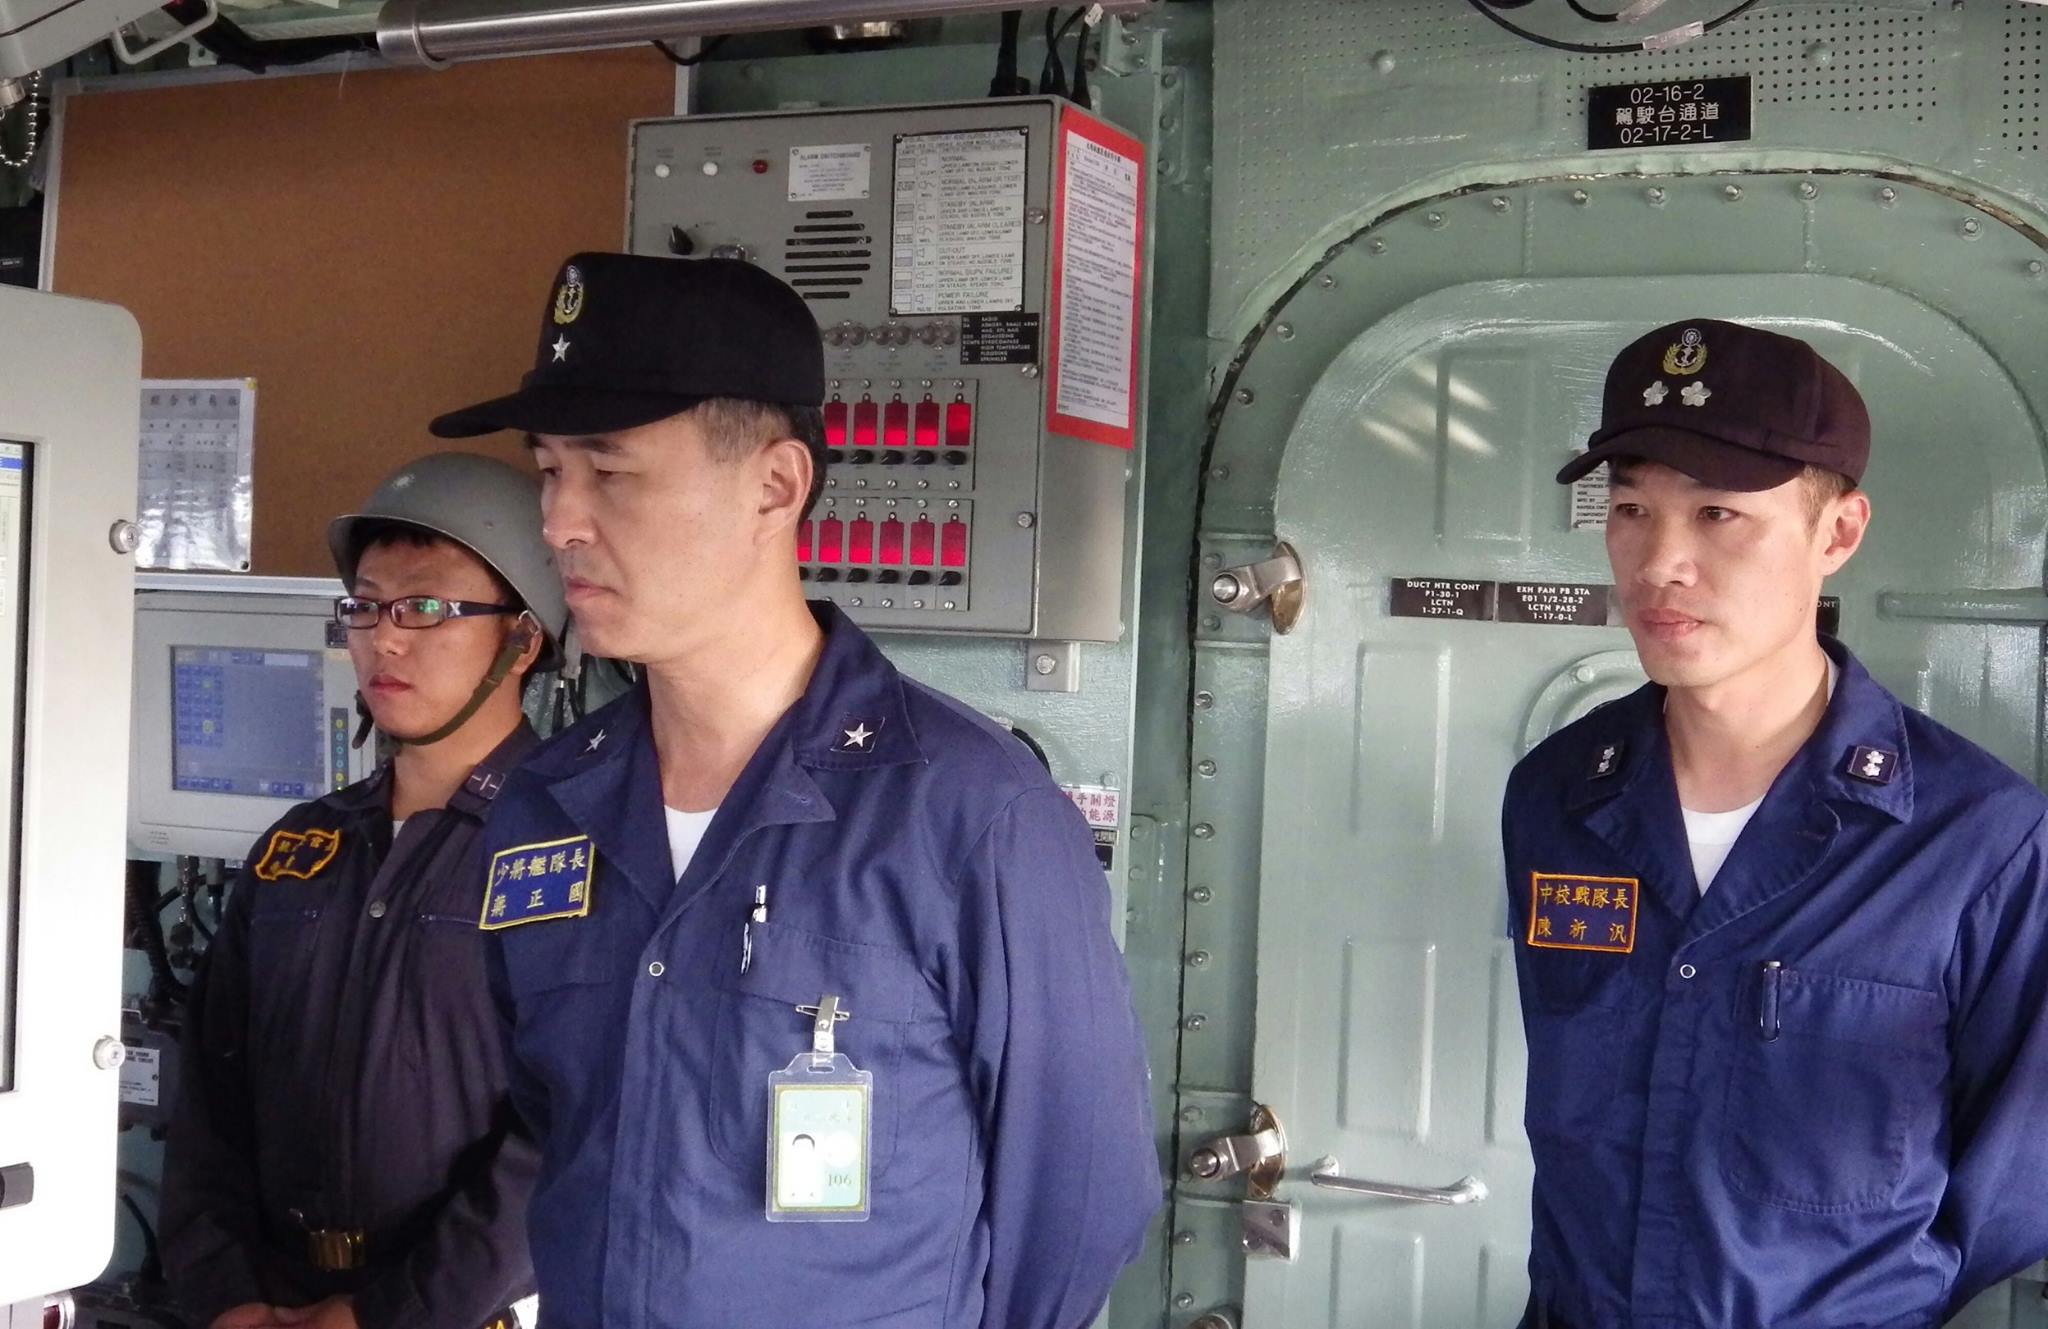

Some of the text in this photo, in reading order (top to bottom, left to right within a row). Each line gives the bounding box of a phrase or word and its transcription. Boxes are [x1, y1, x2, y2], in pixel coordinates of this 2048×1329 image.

[1630, 83, 1704, 104] 02-16-2
[1615, 102, 1719, 126] 駕駛台通道
[1620, 124, 1714, 145] 02-17-2-L
[1425, 590, 1460, 598] P1-30-1
[1434, 582, 1451, 590] HTR
[1454, 583, 1481, 591] CONT
[1422, 606, 1464, 616] 1-27-1-Q
[1817, 600, 1836, 608] ONT
[494, 848, 586, 887] 少將艦隊長
[1540, 882, 1630, 910] 中校戰隊長
